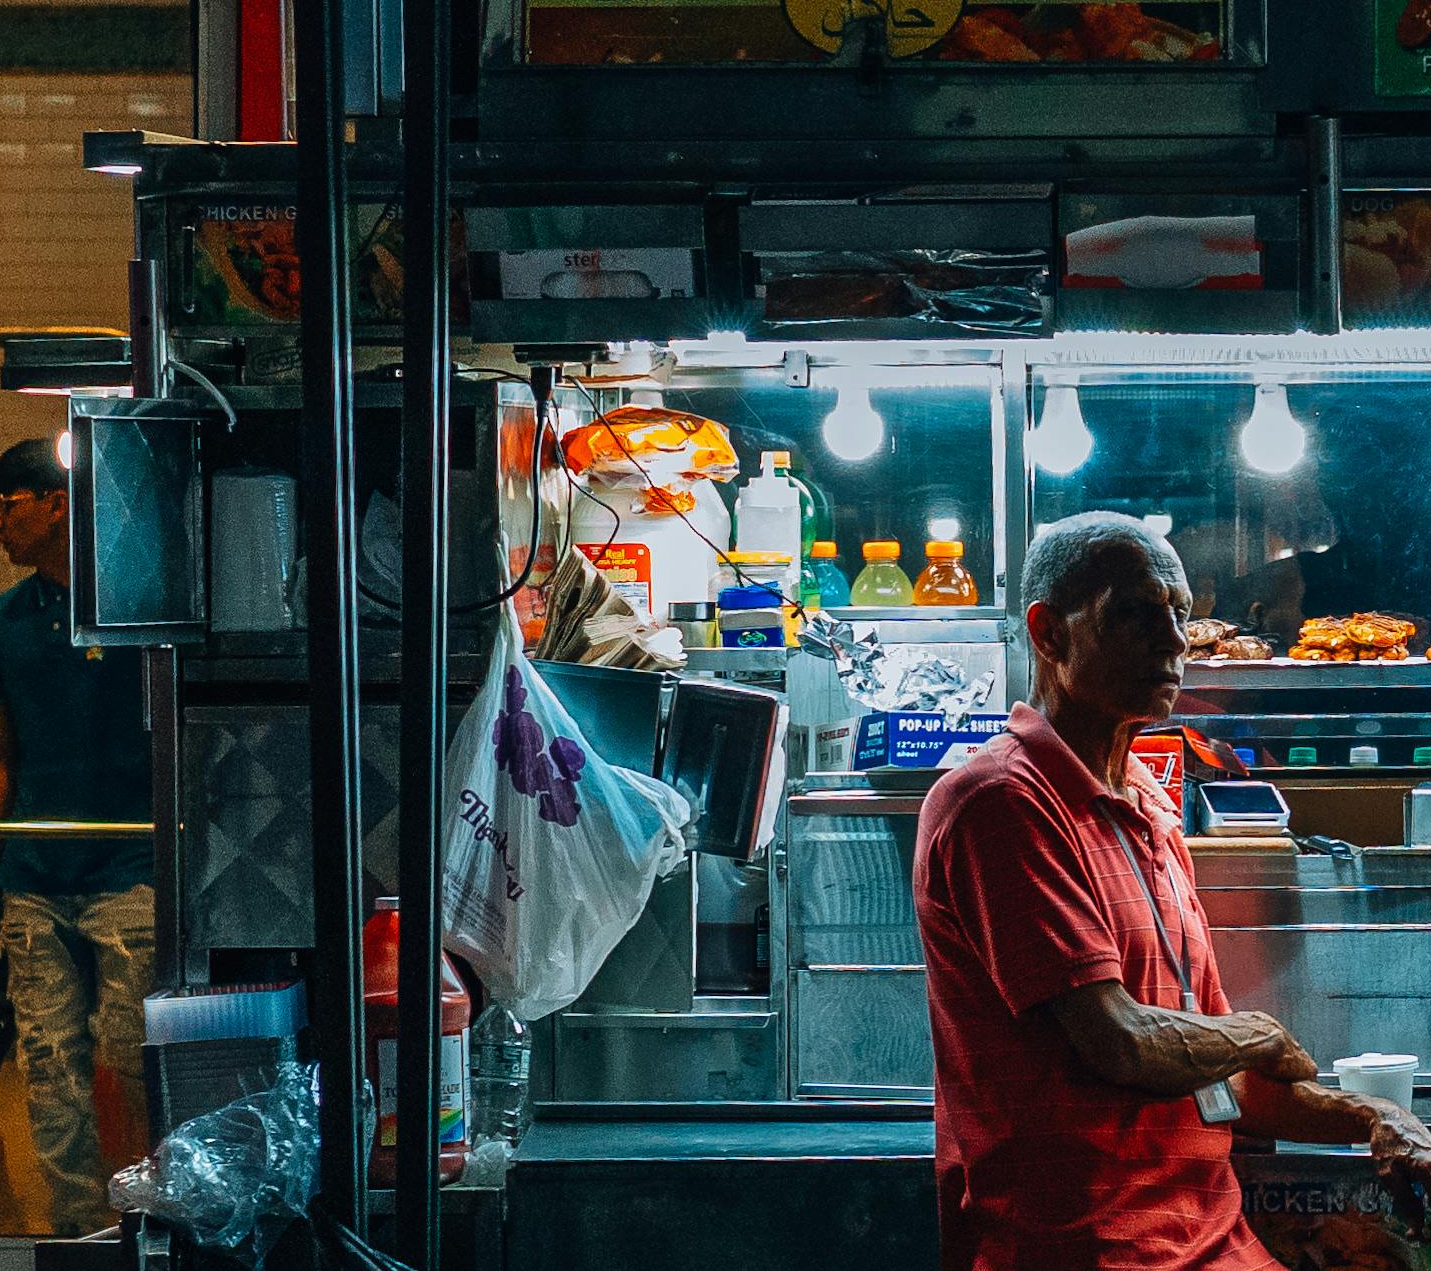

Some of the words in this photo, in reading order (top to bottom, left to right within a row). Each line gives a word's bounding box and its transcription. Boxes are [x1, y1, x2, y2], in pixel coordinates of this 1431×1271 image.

[199, 204, 277, 221] HICKEN
[898, 718, 942, 732] POP-UP
[970, 720, 1008, 734] SHEET
